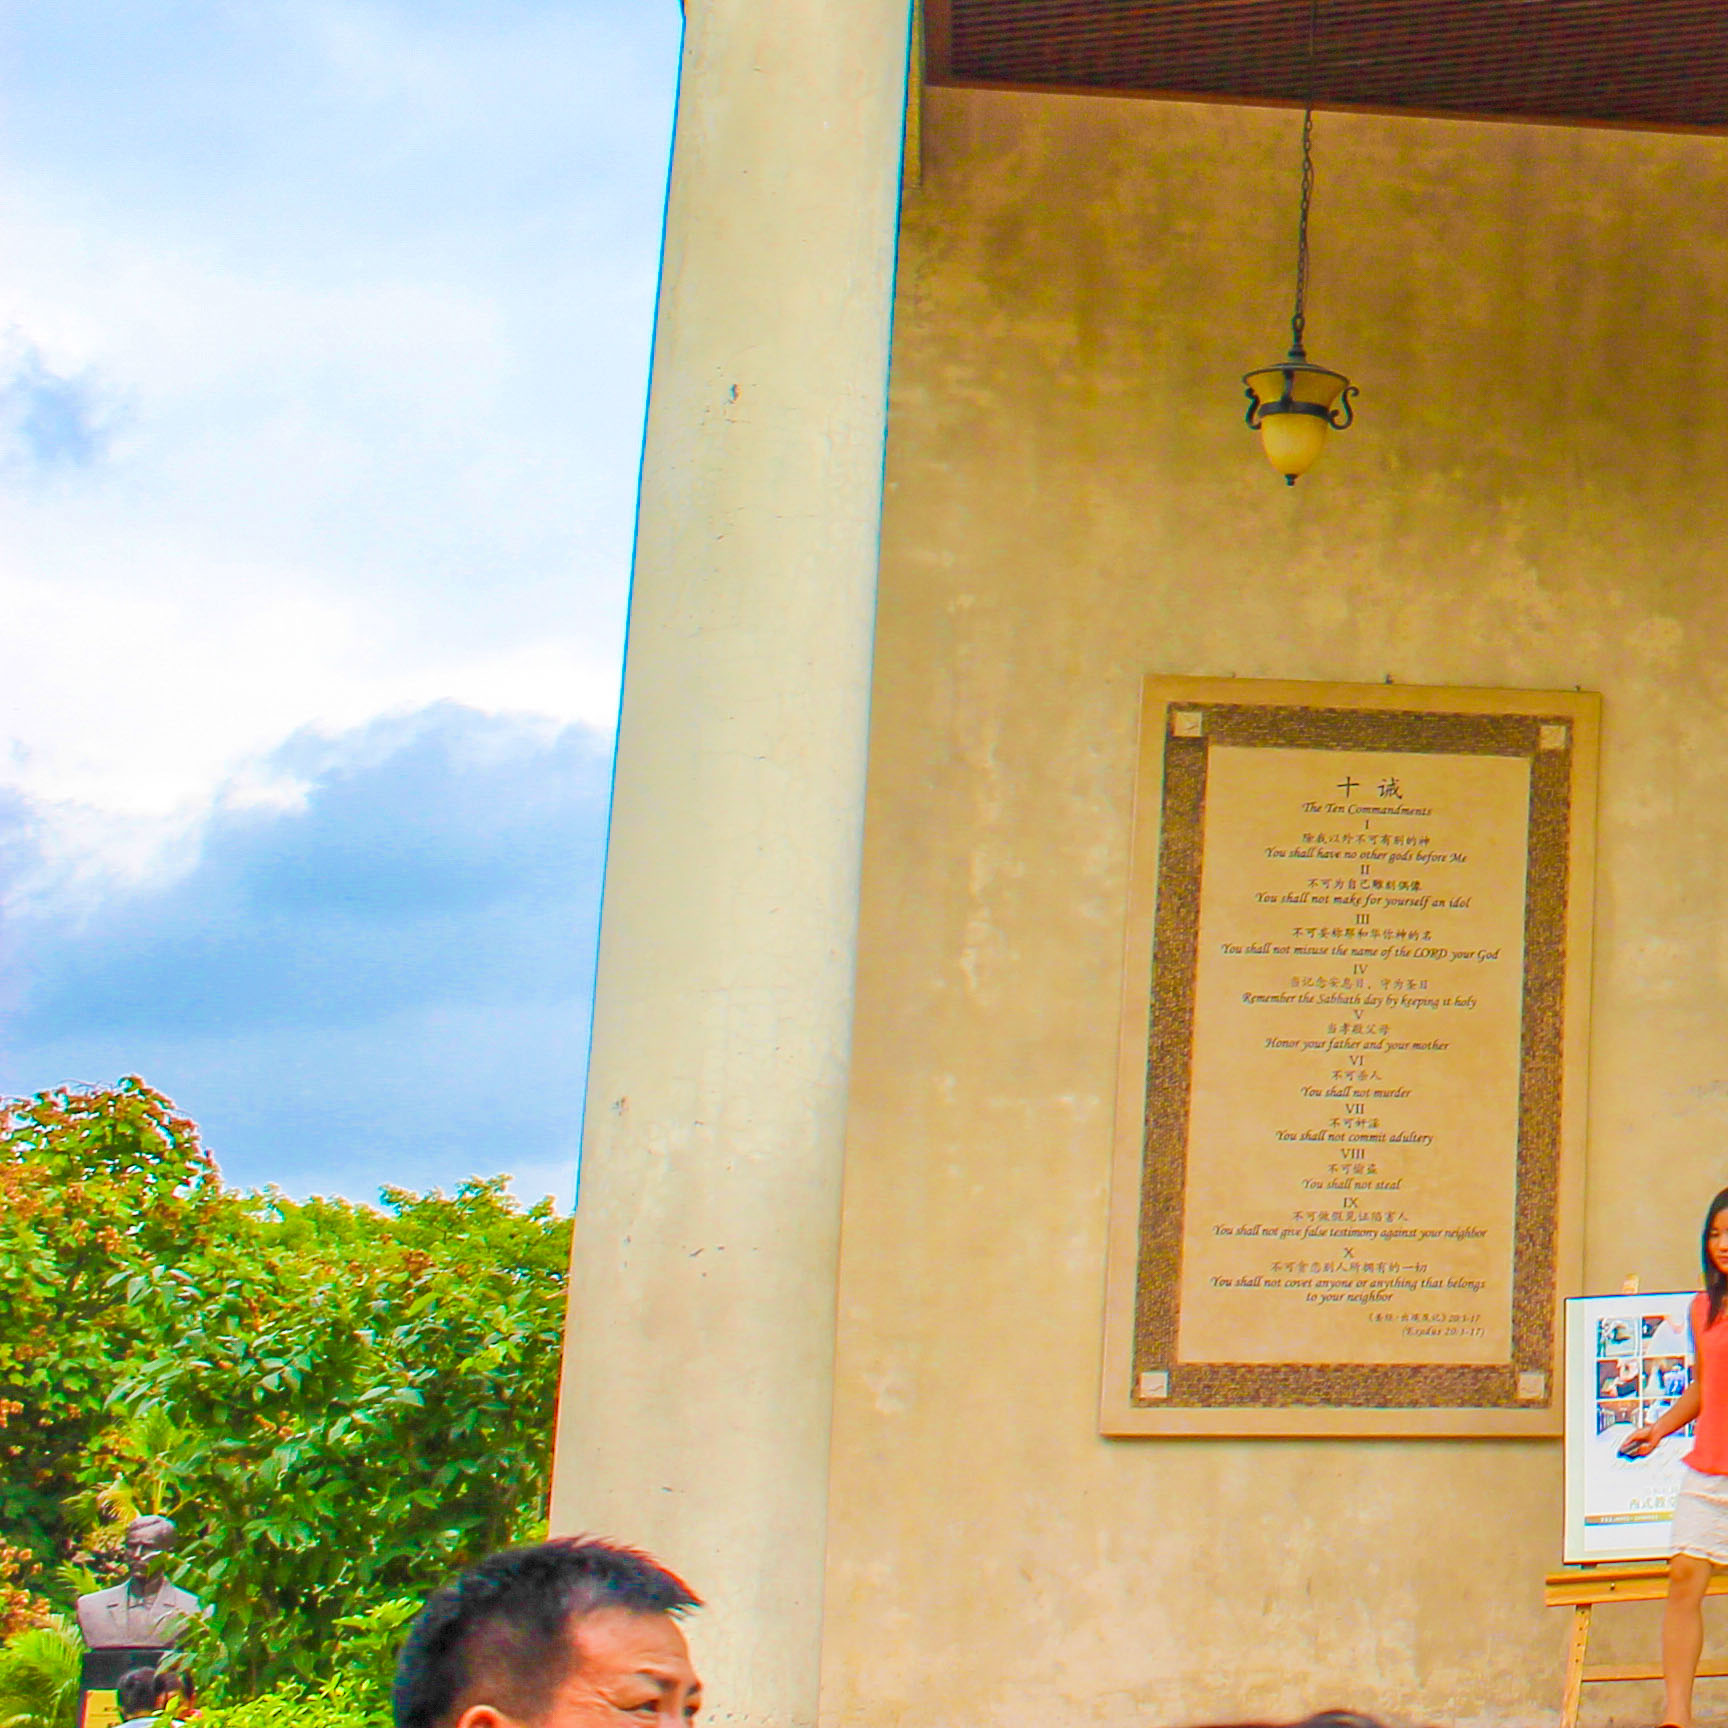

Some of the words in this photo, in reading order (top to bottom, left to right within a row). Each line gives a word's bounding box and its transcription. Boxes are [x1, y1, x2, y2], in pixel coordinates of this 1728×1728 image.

[1302, 801, 1320, 813] The
[1325, 803, 1345, 813] Ten
[1348, 804, 1432, 816] Commandments
[1265, 847, 1286, 858] You
[1288, 847, 1314, 859] shall
[1317, 848, 1340, 859] have
[1360, 850, 1387, 860] other
[1388, 850, 1413, 864] gods
[1416, 851, 1446, 865] before
[1449, 853, 1468, 863] Me
[1361, 864, 1370, 875] II
[1255, 892, 1277, 903] You
[1281, 892, 1310, 903] shall
[1312, 895, 1329, 904] not
[1333, 893, 1360, 907] make
[1362, 893, 1382, 908] for
[1385, 895, 1430, 910] yourself
[1449, 896, 1472, 908] idol
[1356, 914, 1370, 924] III
[1221, 943, 1242, 954] You
[1245, 942, 1272, 954] shall
[1274, 945, 1290, 954] not
[1294, 946, 1328, 955] misuse
[1331, 945, 1347, 955] the
[1352, 948, 1377, 956] name
[1380, 945, 1394, 960] of
[1395, 946, 1410, 957] the
[1413, 947, 1448, 959] LORD
[1450, 953, 1474, 962] your
[1477, 949, 1500, 963] God
[1353, 964, 1368, 975] IV
[1242, 992, 1295, 1004] Remember
[1298, 992, 1314, 1003] the
[1318, 993, 1361, 1004] Sabbath
[1364, 994, 1382, 1008] day
[1386, 994, 1398, 1008] by
[1400, 995, 1440, 1009] keeping
[1443, 997, 1451, 1006] it
[1454, 996, 1477, 1009] holy
[1353, 1009, 1364, 1019] V
[1264, 1038, 1300, 1049] Honor
[1302, 1042, 1326, 1052] your
[1326, 1038, 1361, 1052] father
[1363, 1039, 1386, 1050] and
[1386, 1043, 1410, 1053] your
[1412, 1039, 1450, 1050] mother
[1349, 1055, 1364, 1065] VI
[1301, 1086, 1322, 1097] You
[1324, 1086, 1350, 1098] shall
[1353, 1089, 1371, 1098] not
[1373, 1087, 1413, 1098] murder
[1345, 1103, 1364, 1114] VII
[1276, 1130, 1297, 1141] You
[1299, 1130, 1328, 1142] shall
[1328, 1133, 1345, 1142] not
[1349, 1133, 1387, 1143] commit
[1389, 1131, 1433, 1146] adultery
[1340, 1148, 1365, 1159] VIII
[1302, 1178, 1323, 1189] You
[1326, 1178, 1353, 1190] shall
[1354, 1182, 1372, 1190] not
[1375, 1178, 1403, 1190] steal
[1343, 1197, 1359, 1208] IX
[1213, 1224, 1233, 1235] You
[1235, 1224, 1261, 1236] shall
[1262, 1228, 1278, 1236] not
[1280, 1227, 1301, 1240] give
[1302, 1225, 1325, 1240] false
[1329, 1227, 1377, 1240] testimony
[1380, 1228, 1417, 1240] against
[1418, 1232, 1443, 1241] your
[1444, 1226, 1488, 1240] neighbor
[1343, 1247, 1355, 1258] X
[1210, 1275, 1233, 1286] You
[1235, 1275, 1263, 1287] shall
[1264, 1279, 1281, 1288] not
[1284, 1279, 1312, 1288] covet
[1315, 1280, 1352, 1291] anyone
[1356, 1280, 1366, 1288] or
[1369, 1278, 1417, 1291] anything
[1420, 1278, 1443, 1288] that
[1446, 1276, 1486, 1292] belongs
[1305, 1292, 1318, 1302] to
[1319, 1293, 1345, 1305] your
[1347, 1289, 1393, 1305] neighbor
